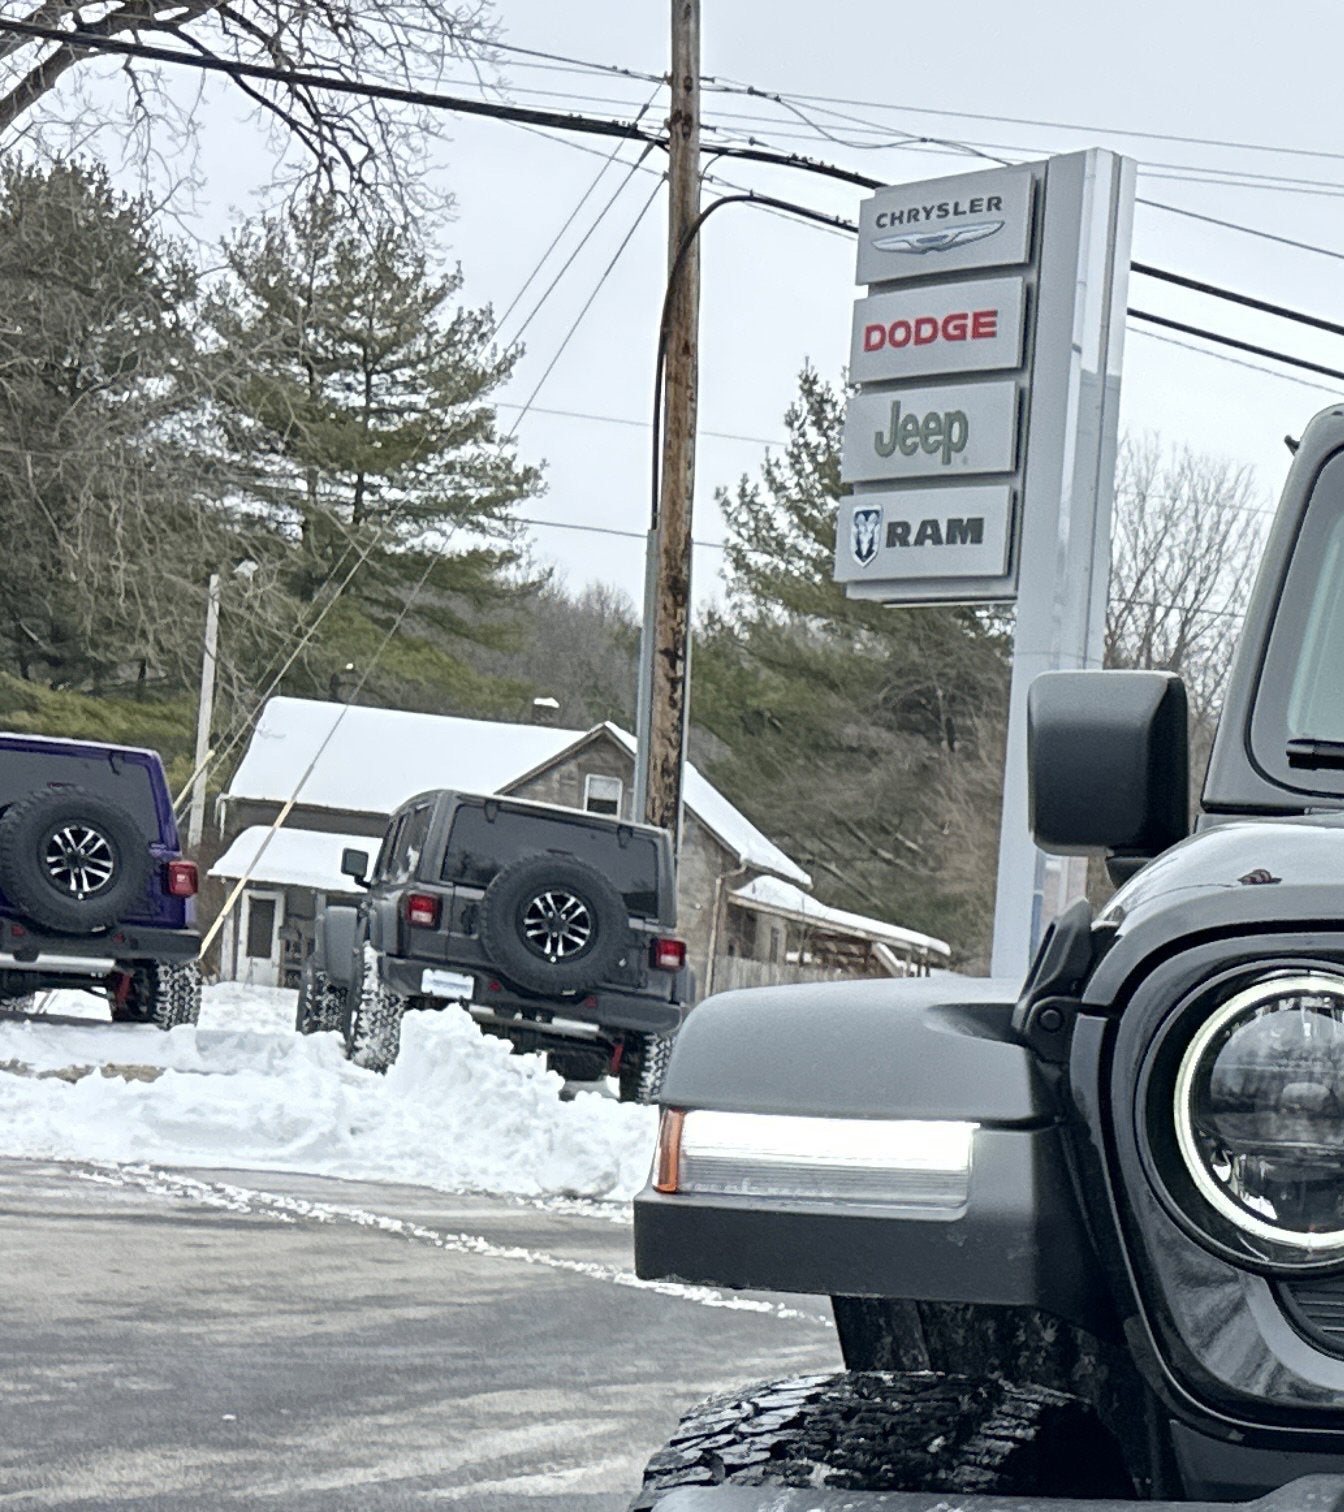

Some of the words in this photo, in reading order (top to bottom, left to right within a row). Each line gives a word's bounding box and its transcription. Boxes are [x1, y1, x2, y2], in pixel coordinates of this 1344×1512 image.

[875, 196, 1003, 230] CHRYSLER
[863, 309, 999, 353] DODGE
[873, 400, 969, 465] Jeep
[885, 516, 985, 548] RAM
